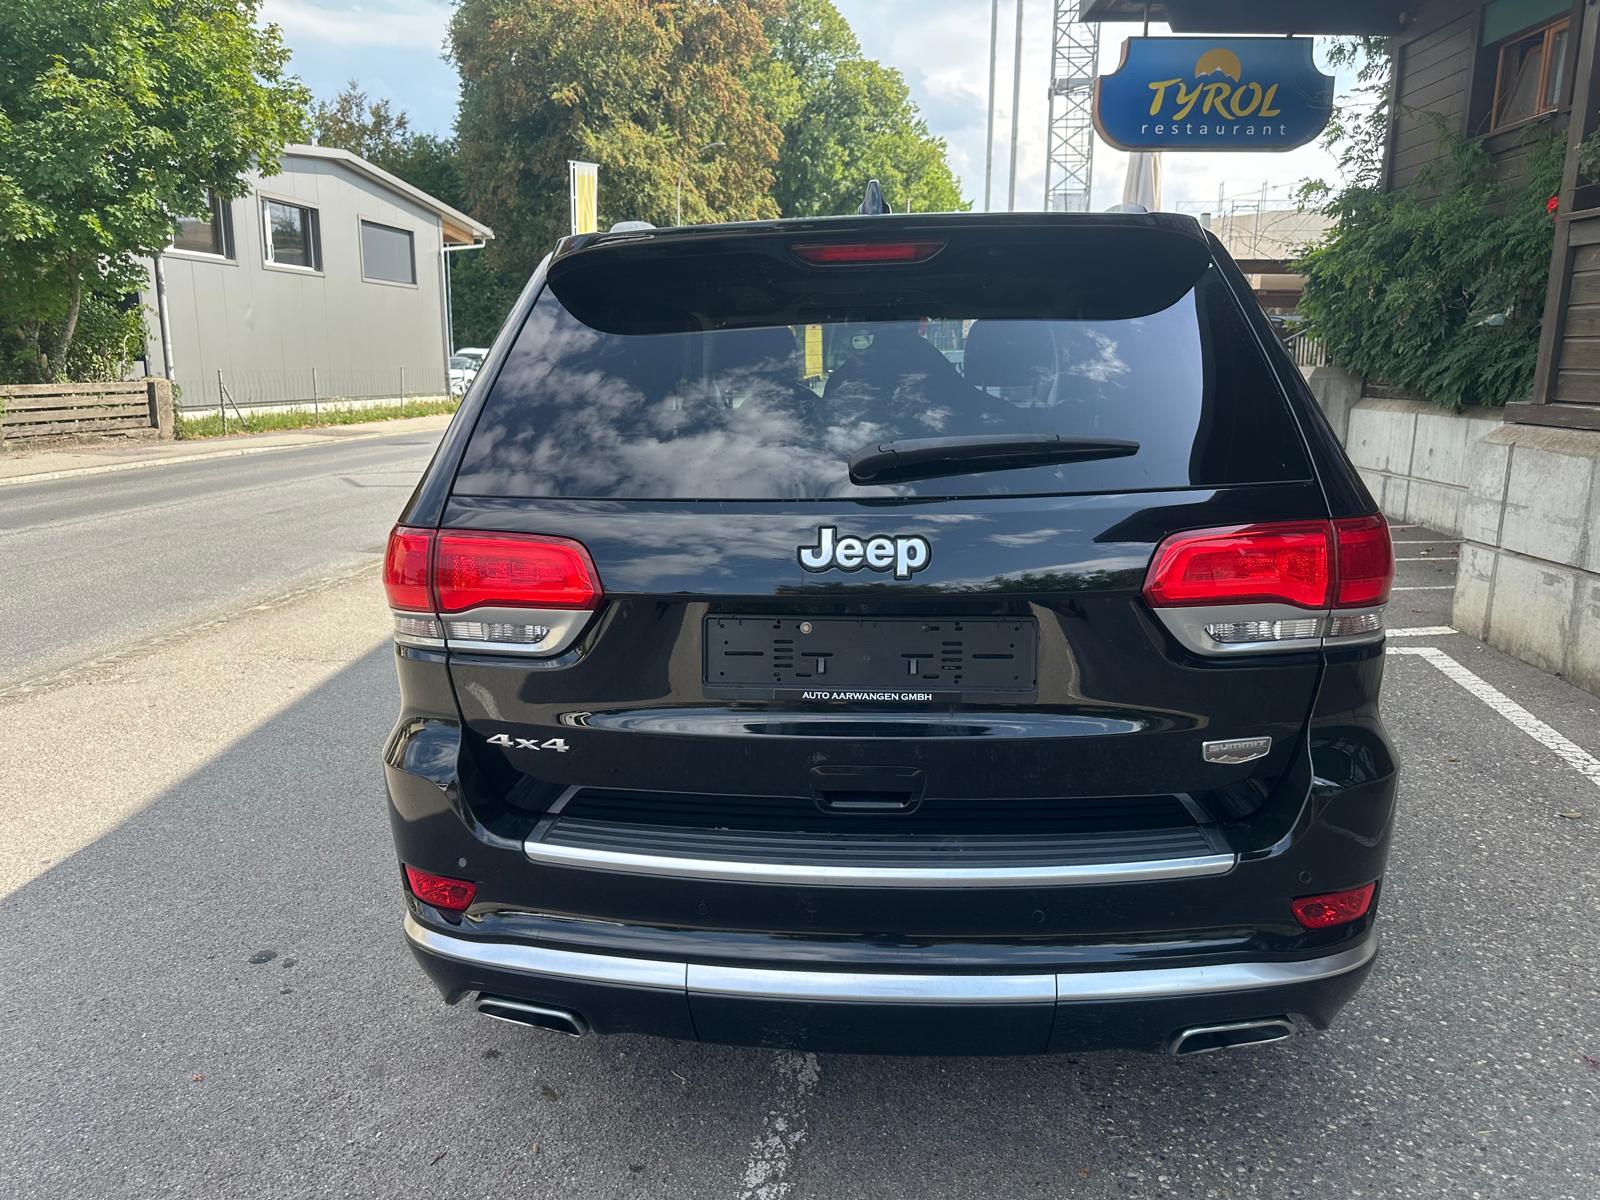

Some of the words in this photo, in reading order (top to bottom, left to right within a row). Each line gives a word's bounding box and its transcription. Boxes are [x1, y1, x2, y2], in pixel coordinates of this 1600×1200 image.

[1148, 78, 1281, 121] TYROL
[1141, 122, 1286, 136] restaurant
[799, 526, 929, 578] Jeep
[802, 691, 830, 699] AUTO
[831, 692, 899, 701] AARWANGEN
[900, 693, 932, 701] GMBH
[486, 733, 570, 753] 4x4
